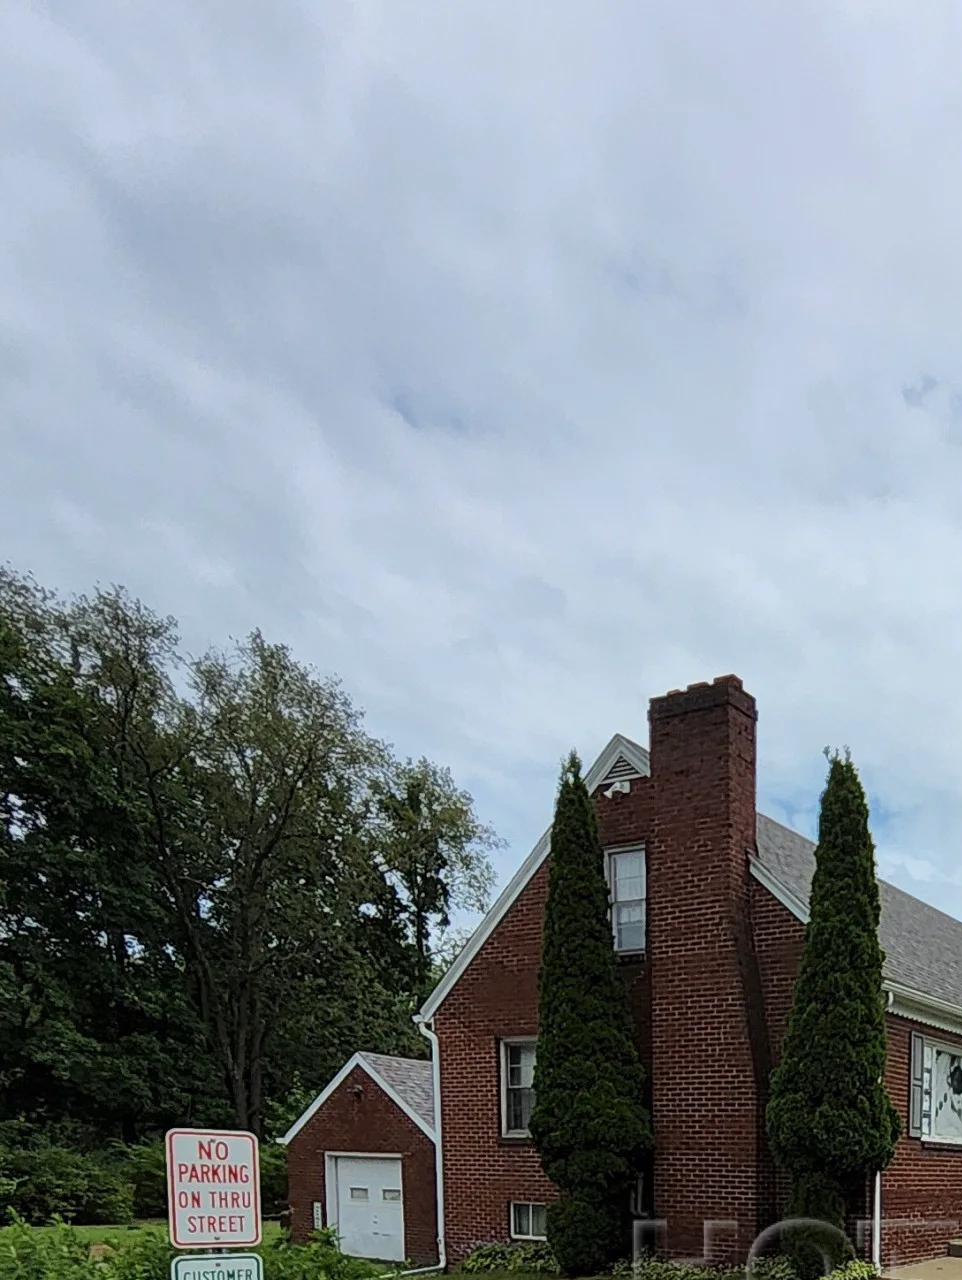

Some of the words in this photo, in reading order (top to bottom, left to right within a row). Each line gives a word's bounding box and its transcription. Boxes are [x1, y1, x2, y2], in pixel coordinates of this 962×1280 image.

[198, 1140, 229, 1161] NO
[178, 1163, 249, 1184] PARKING
[178, 1191, 201, 1209] ON
[209, 1190, 251, 1209] THRU
[187, 1215, 246, 1234] STREET
